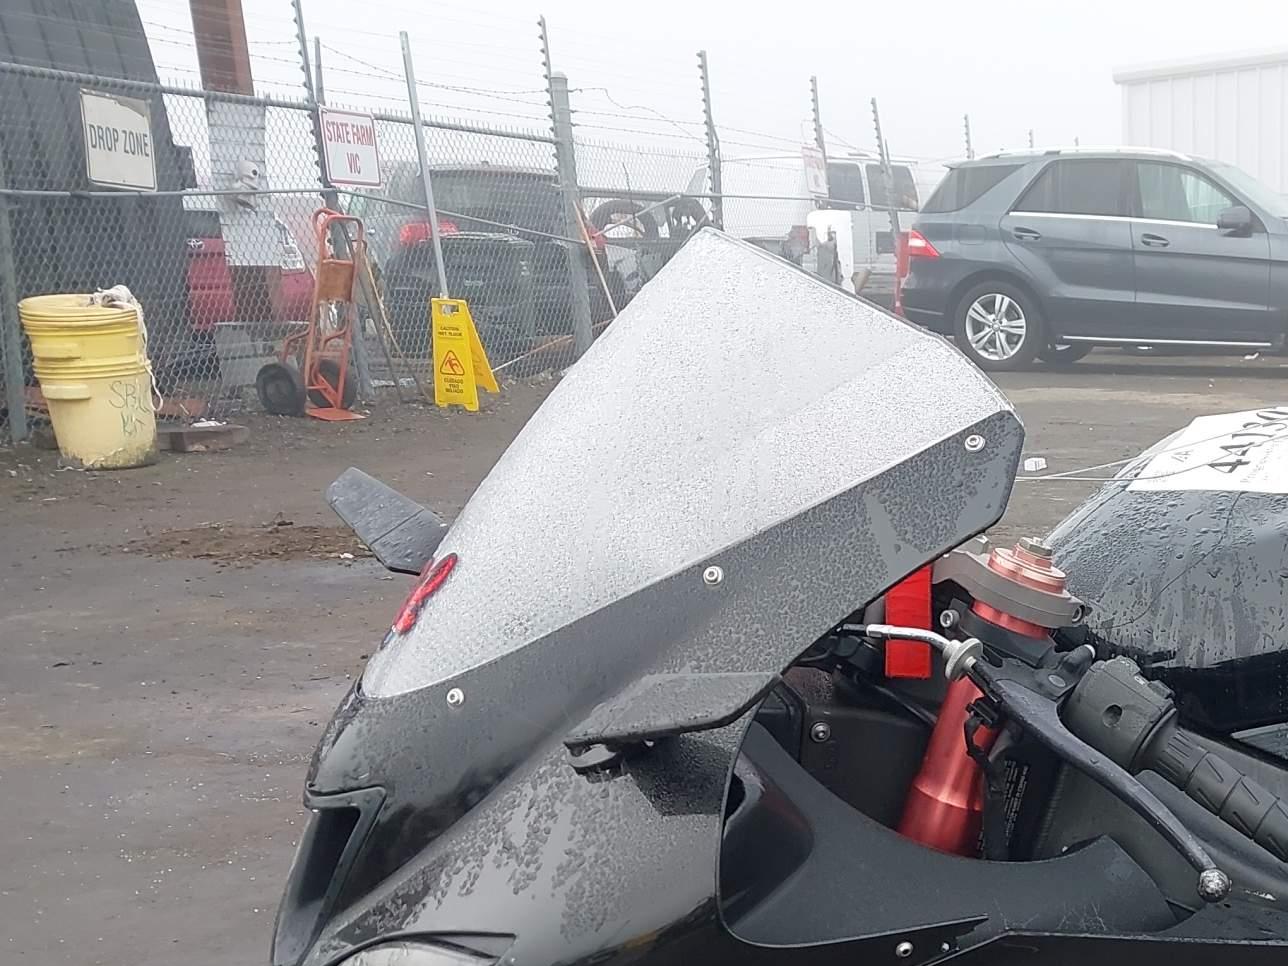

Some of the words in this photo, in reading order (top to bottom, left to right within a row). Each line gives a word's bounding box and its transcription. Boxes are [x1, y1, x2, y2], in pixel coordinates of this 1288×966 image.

[88, 123, 119, 152] DROP
[121, 129, 150, 157] ZONE
[326, 120, 351, 144] STATE
[351, 124, 374, 146] FARM
[346, 151, 361, 174] VIC
